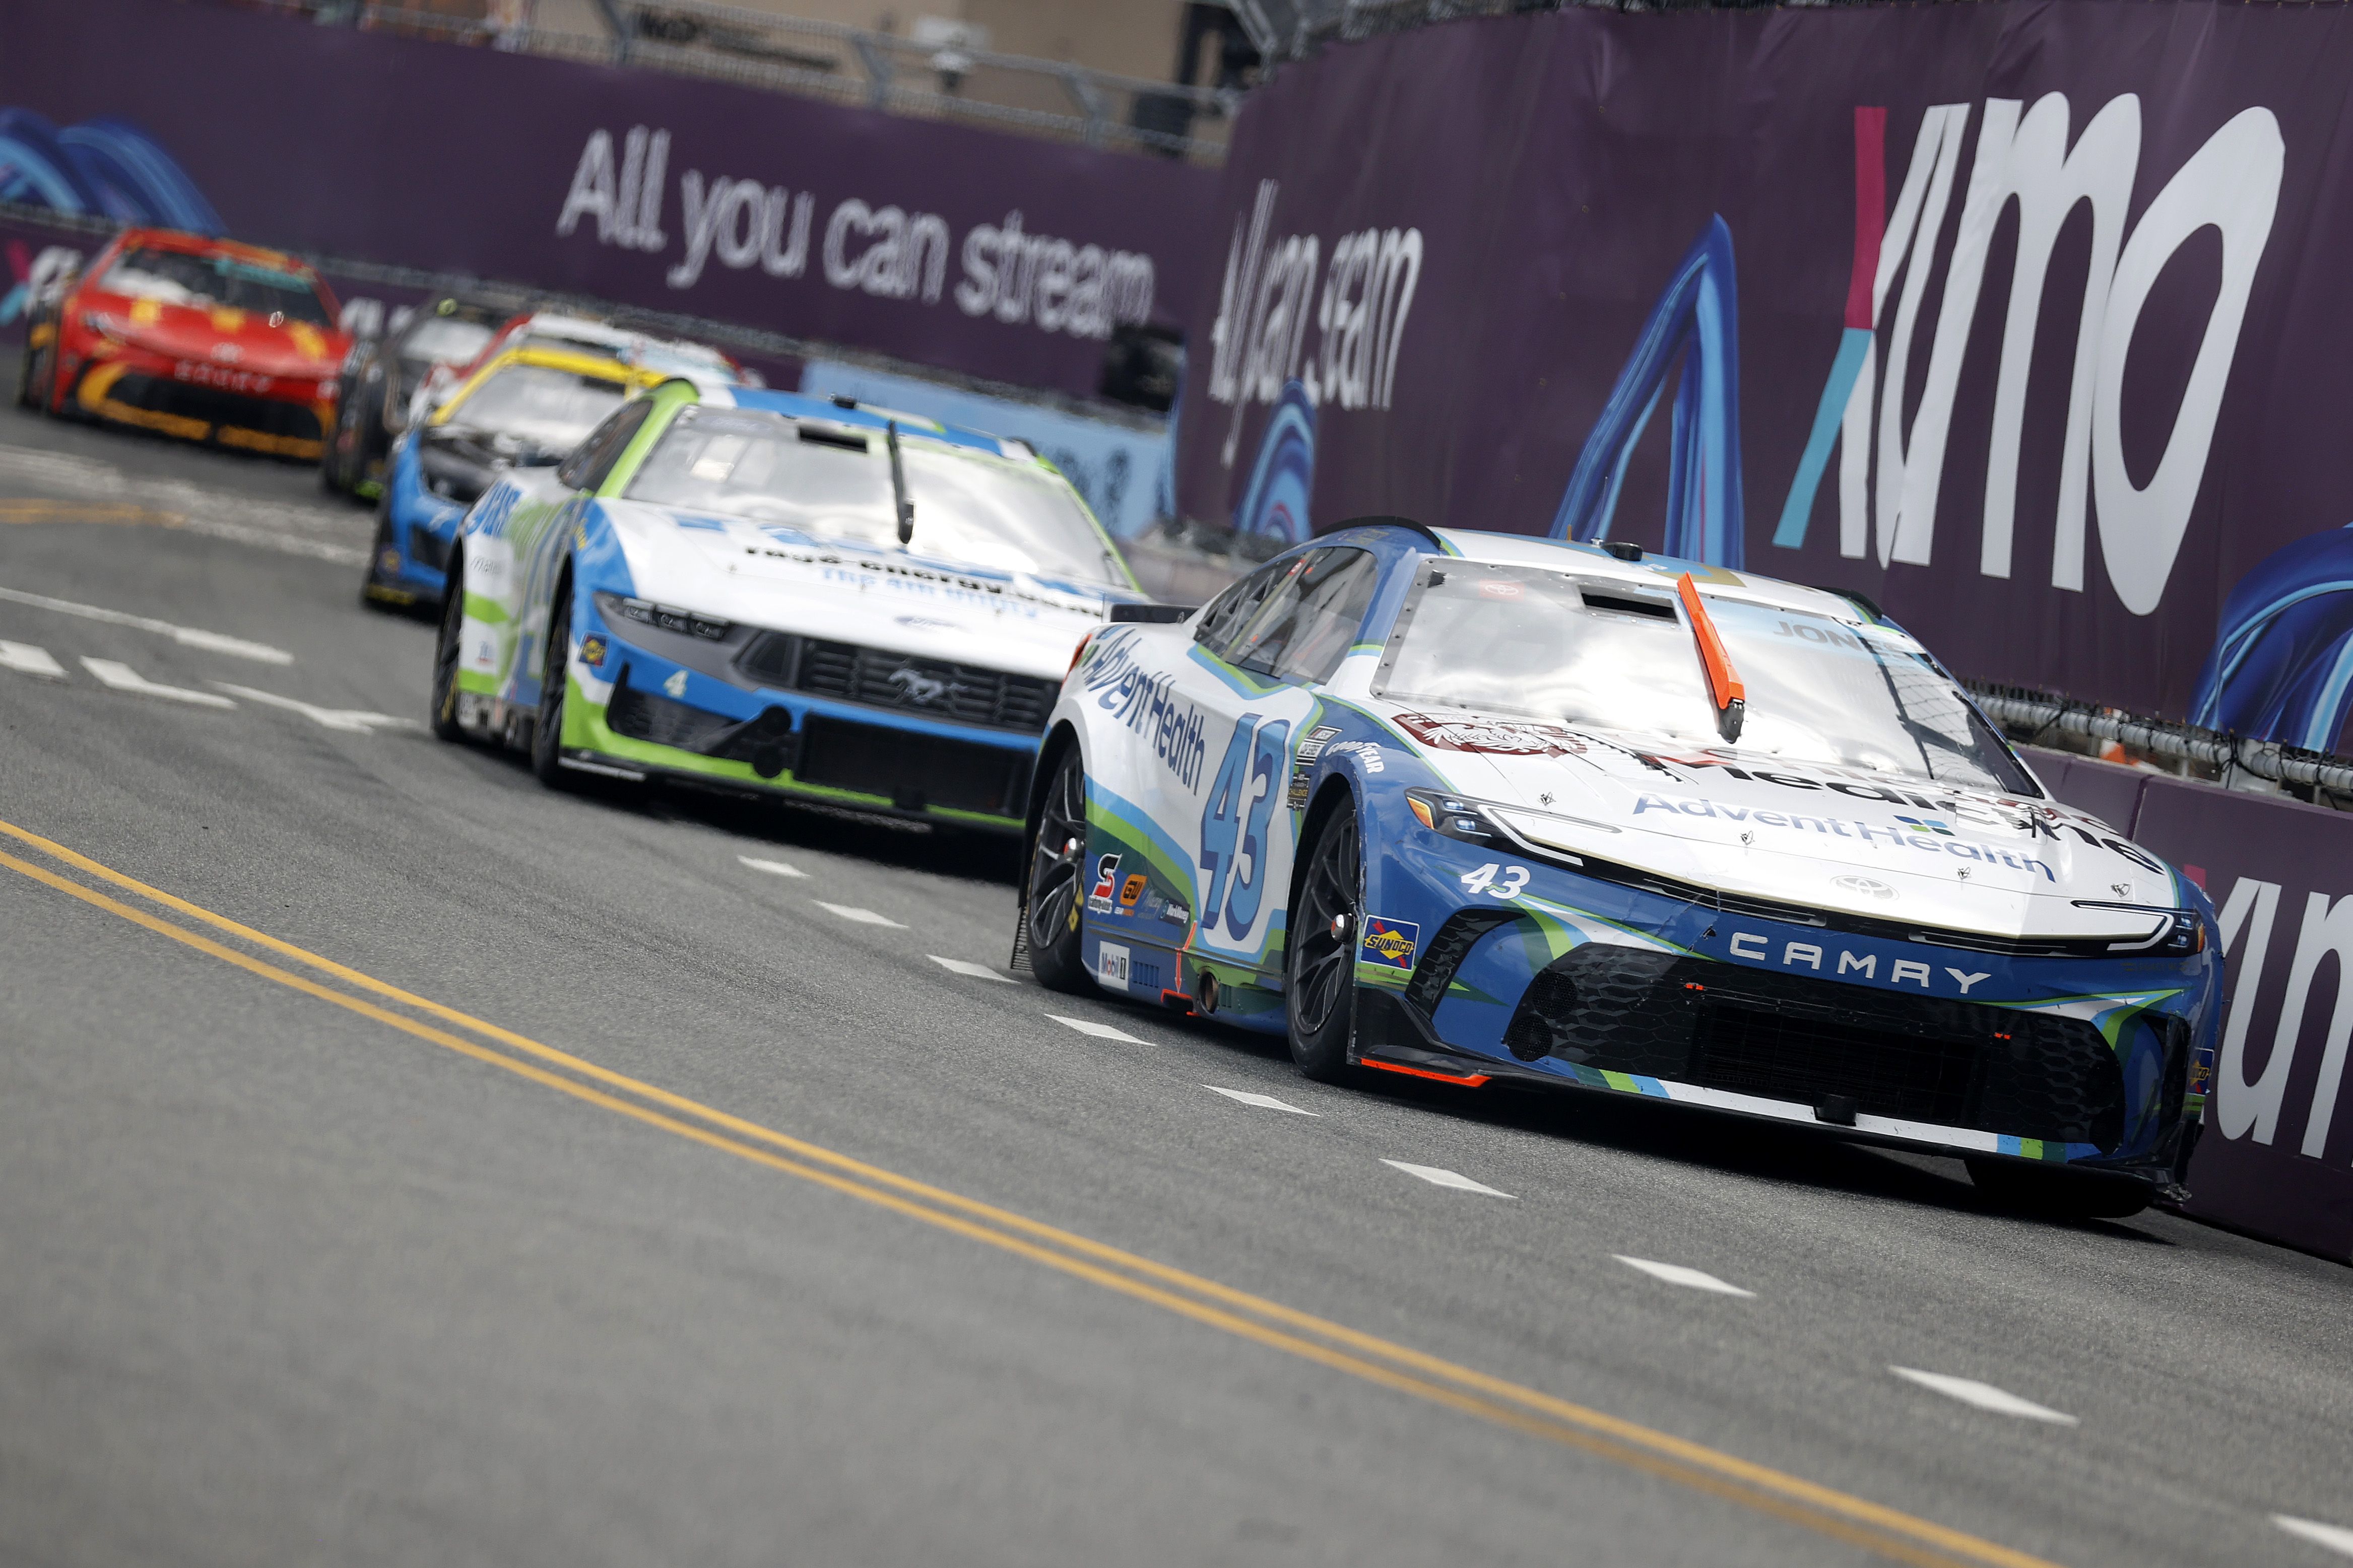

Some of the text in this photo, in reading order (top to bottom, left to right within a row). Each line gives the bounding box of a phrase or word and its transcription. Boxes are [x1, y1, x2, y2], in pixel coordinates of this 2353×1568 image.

[556, 123, 673, 253] All
[666, 167, 815, 289] you
[822, 197, 951, 304] can
[953, 209, 1156, 340] stream
[664, 670, 689, 698] 4
[1325, 741, 1385, 774] GOODYEAR
[1200, 712, 1291, 941] 43
[1461, 863, 1531, 899] 43
[1366, 935, 1412, 953] SUNOCO
[1729, 931, 1992, 994] CAMRY
